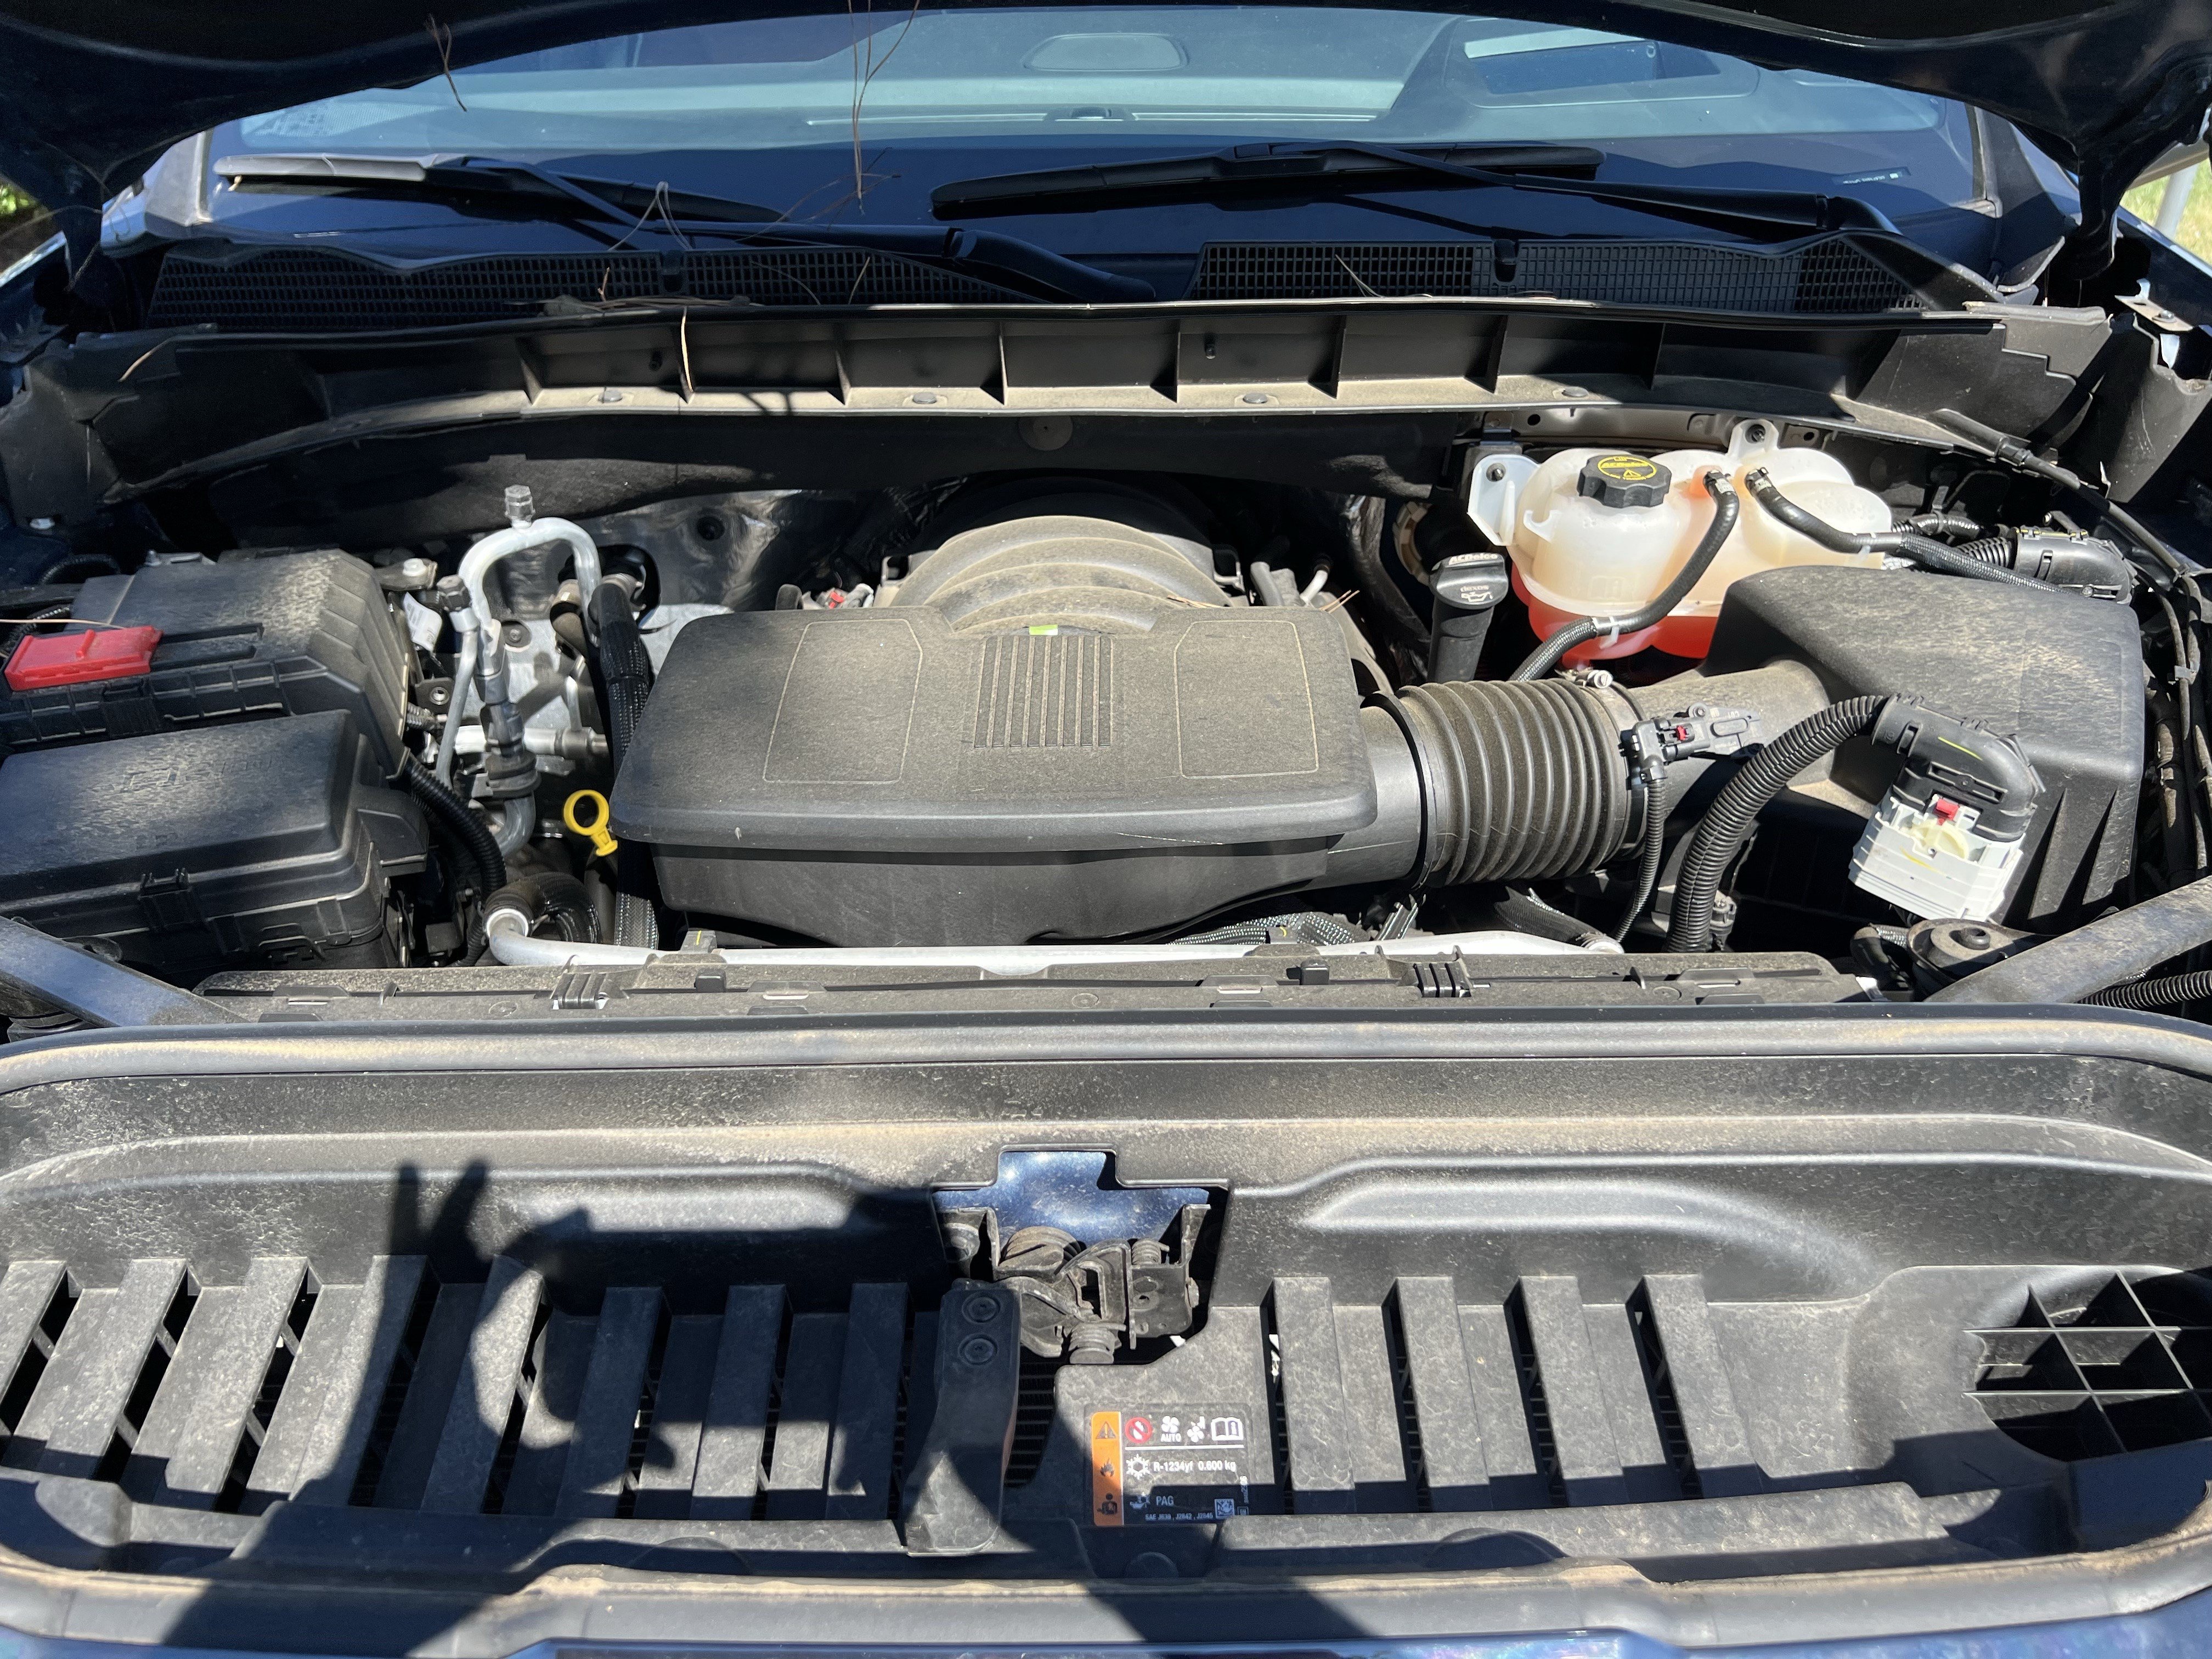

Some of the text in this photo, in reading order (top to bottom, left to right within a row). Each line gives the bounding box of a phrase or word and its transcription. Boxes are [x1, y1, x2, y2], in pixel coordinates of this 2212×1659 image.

[1448, 552, 1498, 565] ACDelco
[1160, 1434, 1181, 1442] AUTO
[1153, 1460, 1193, 1473] R-1234yf
[1224, 1459, 1237, 1472] kg
[1155, 1496, 1174, 1506] PAG
